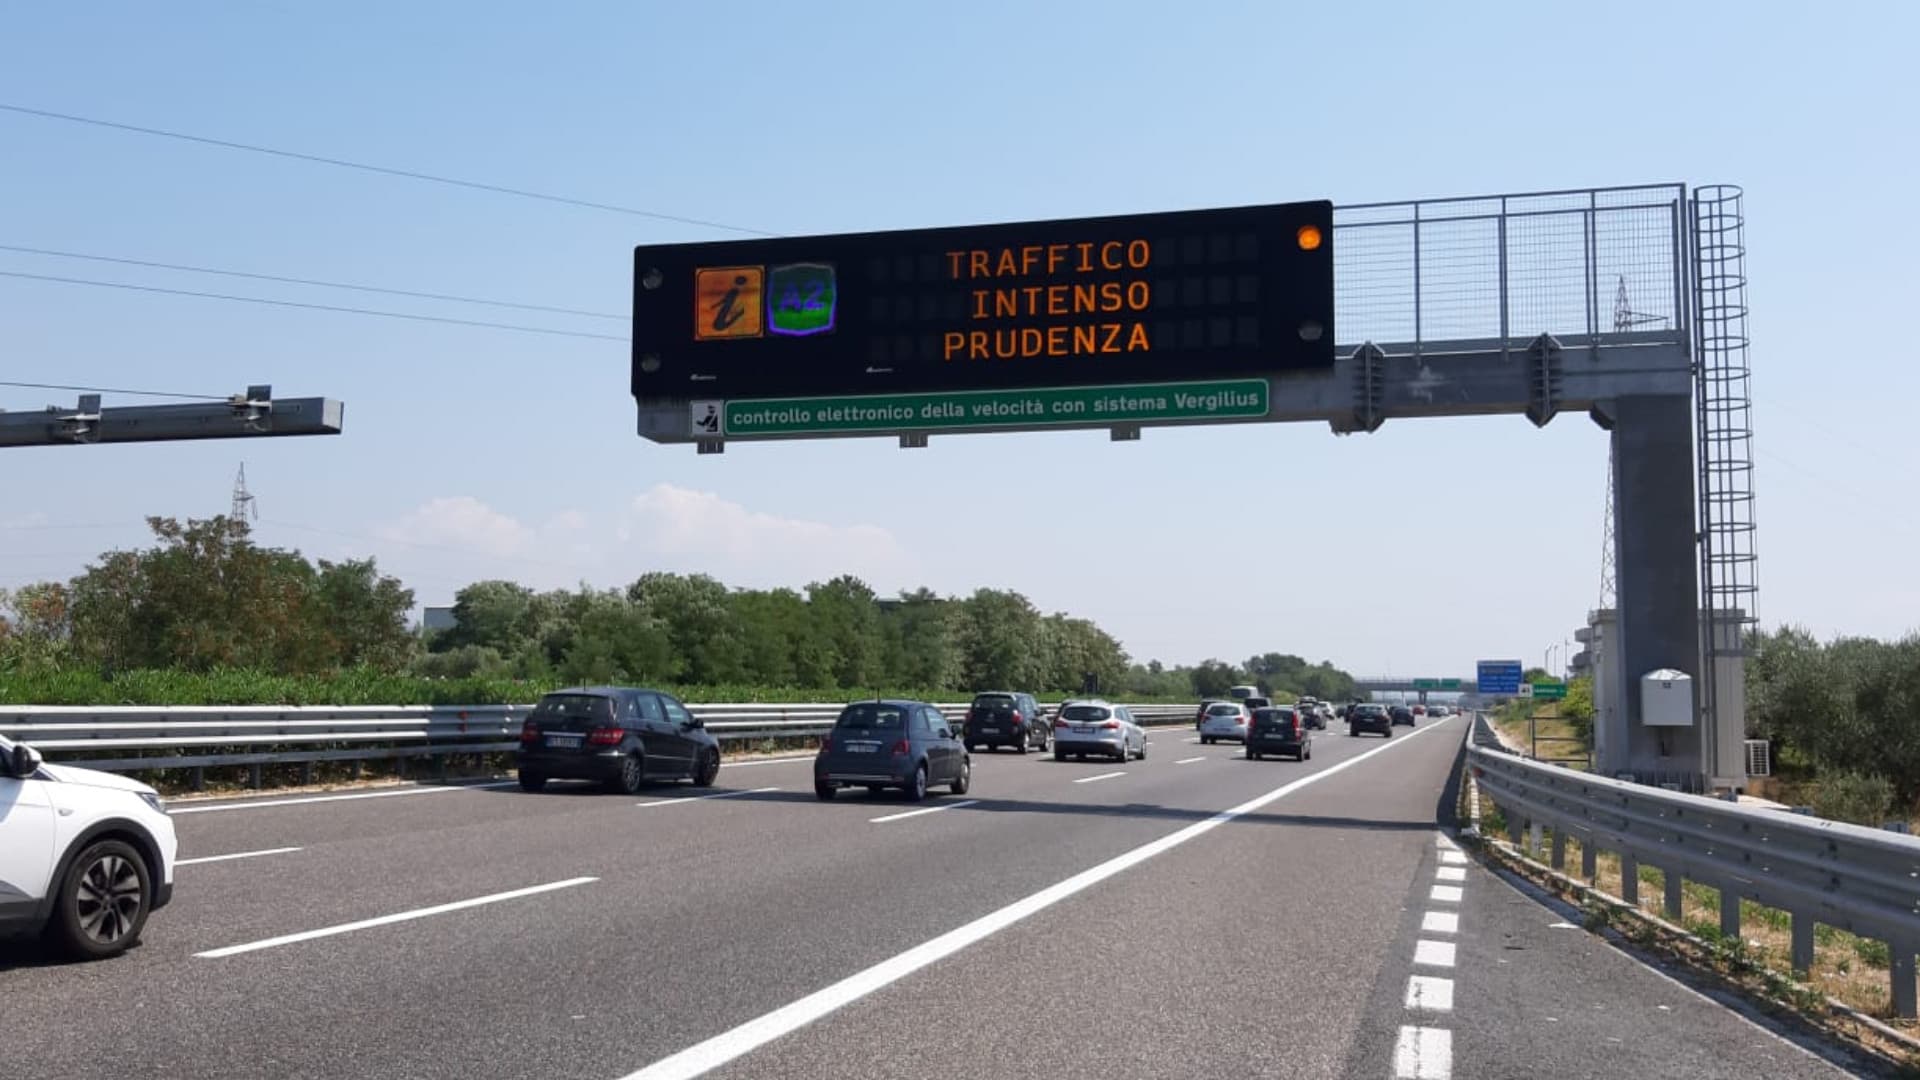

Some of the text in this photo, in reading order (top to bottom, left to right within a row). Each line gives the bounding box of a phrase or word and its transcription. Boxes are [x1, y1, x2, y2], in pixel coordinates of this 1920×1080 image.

[946, 240, 1150, 279] TRAFFICO
[779, 279, 825, 312] A2
[972, 281, 1150, 319] INTENSO
[944, 323, 1150, 361] PRUDENZA
[733, 391, 1259, 425] controllo elettronico della velocità con sistema Vergilius
